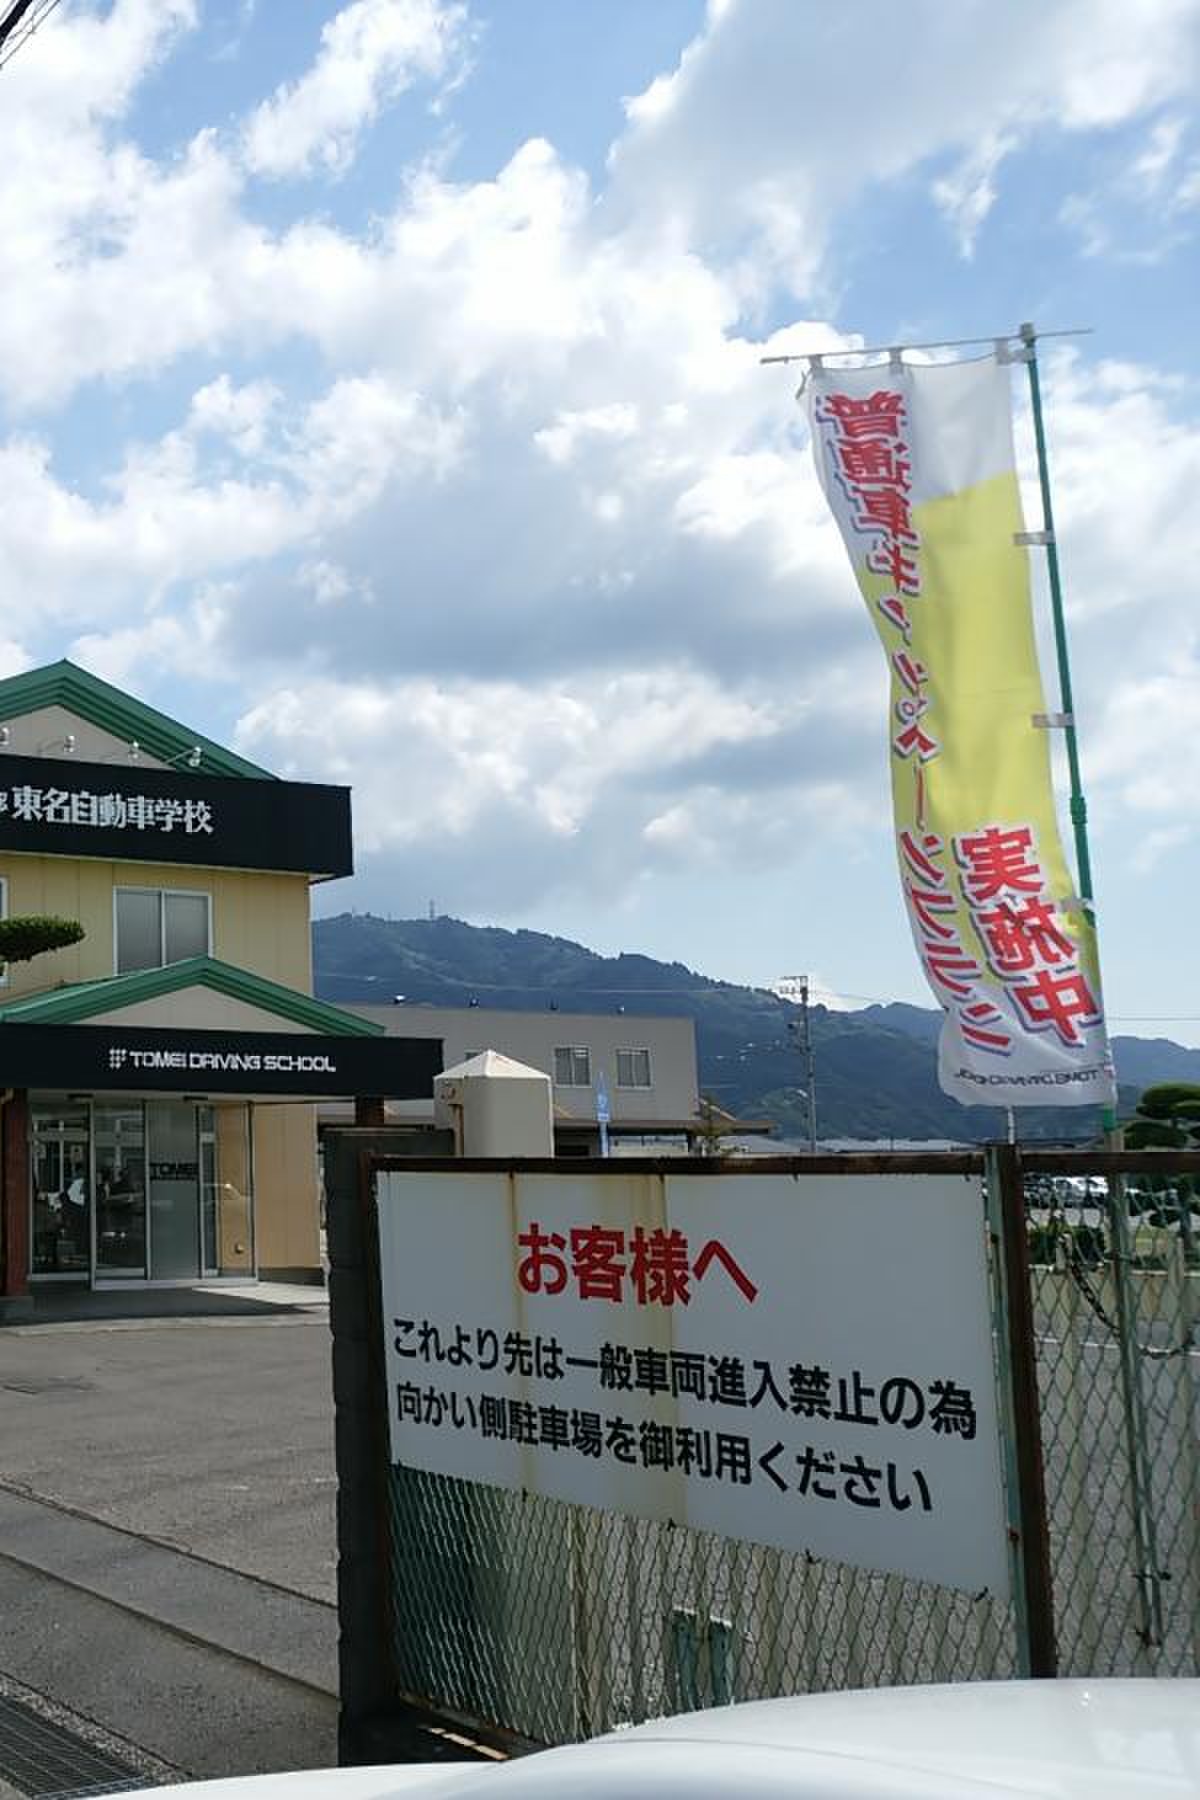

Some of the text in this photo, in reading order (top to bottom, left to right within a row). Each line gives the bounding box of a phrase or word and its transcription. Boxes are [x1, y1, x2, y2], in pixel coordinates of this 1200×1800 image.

[10, 784, 215, 835] 東名自動車学校
[129, 1050, 336, 1073] TOMEI DRIVING SCHOOL
[517, 1222, 758, 1307] お客様へ
[393, 1317, 977, 1441] これより先は一般車両進入禁止の為
[395, 1382, 933, 1512] 向かい側駐車場を御利用ください
